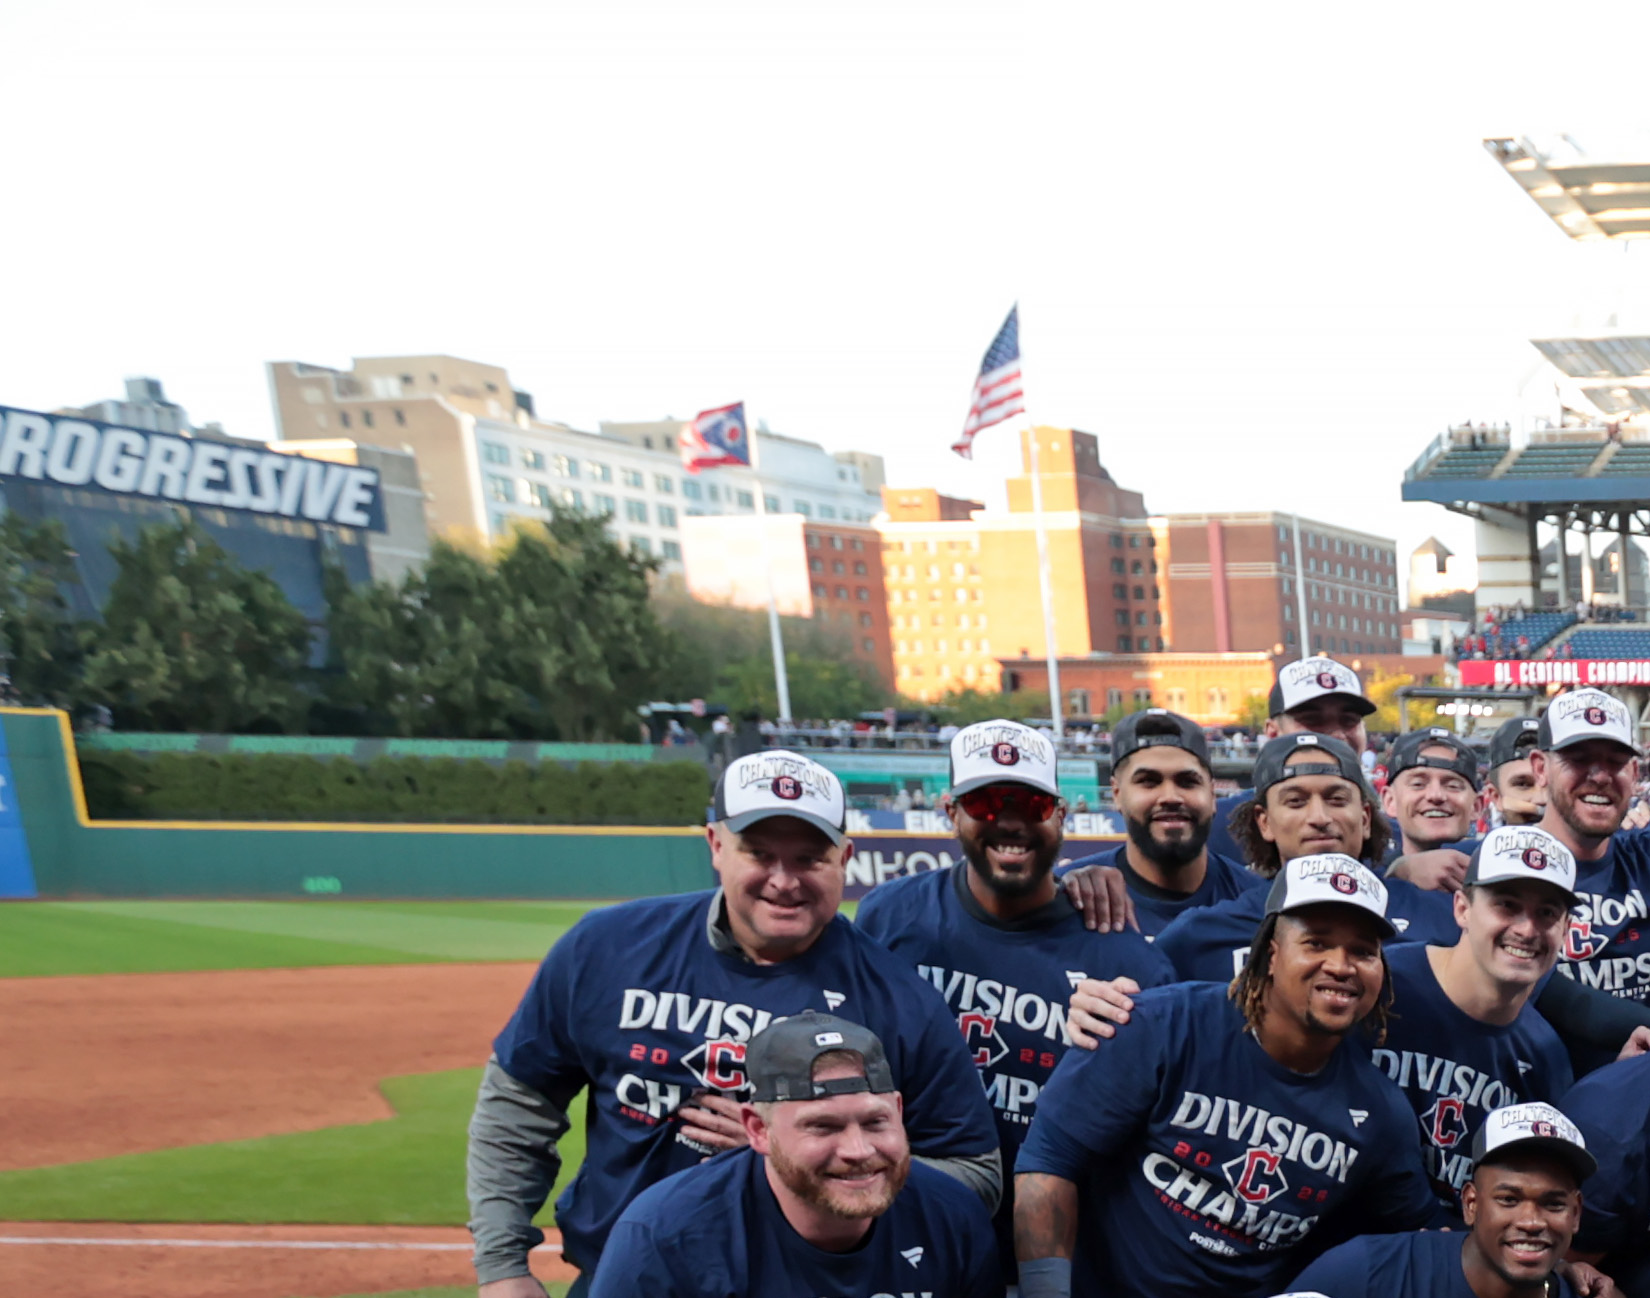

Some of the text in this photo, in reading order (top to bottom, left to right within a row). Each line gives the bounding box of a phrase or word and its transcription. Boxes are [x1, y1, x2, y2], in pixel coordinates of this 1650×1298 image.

[0, 411, 379, 528] ROGRESSIVE
[740, 762, 832, 800] CHAMPIONS
[1494, 837, 1571, 874] CHAMPIONS
[1299, 864, 1381, 902] CHAMPIONS
[704, 1041, 748, 1092] C
[1170, 1091, 1358, 1184] DIVISION
[1142, 1152, 1320, 1245] CHAMPS
[1234, 1150, 1281, 1203] C
